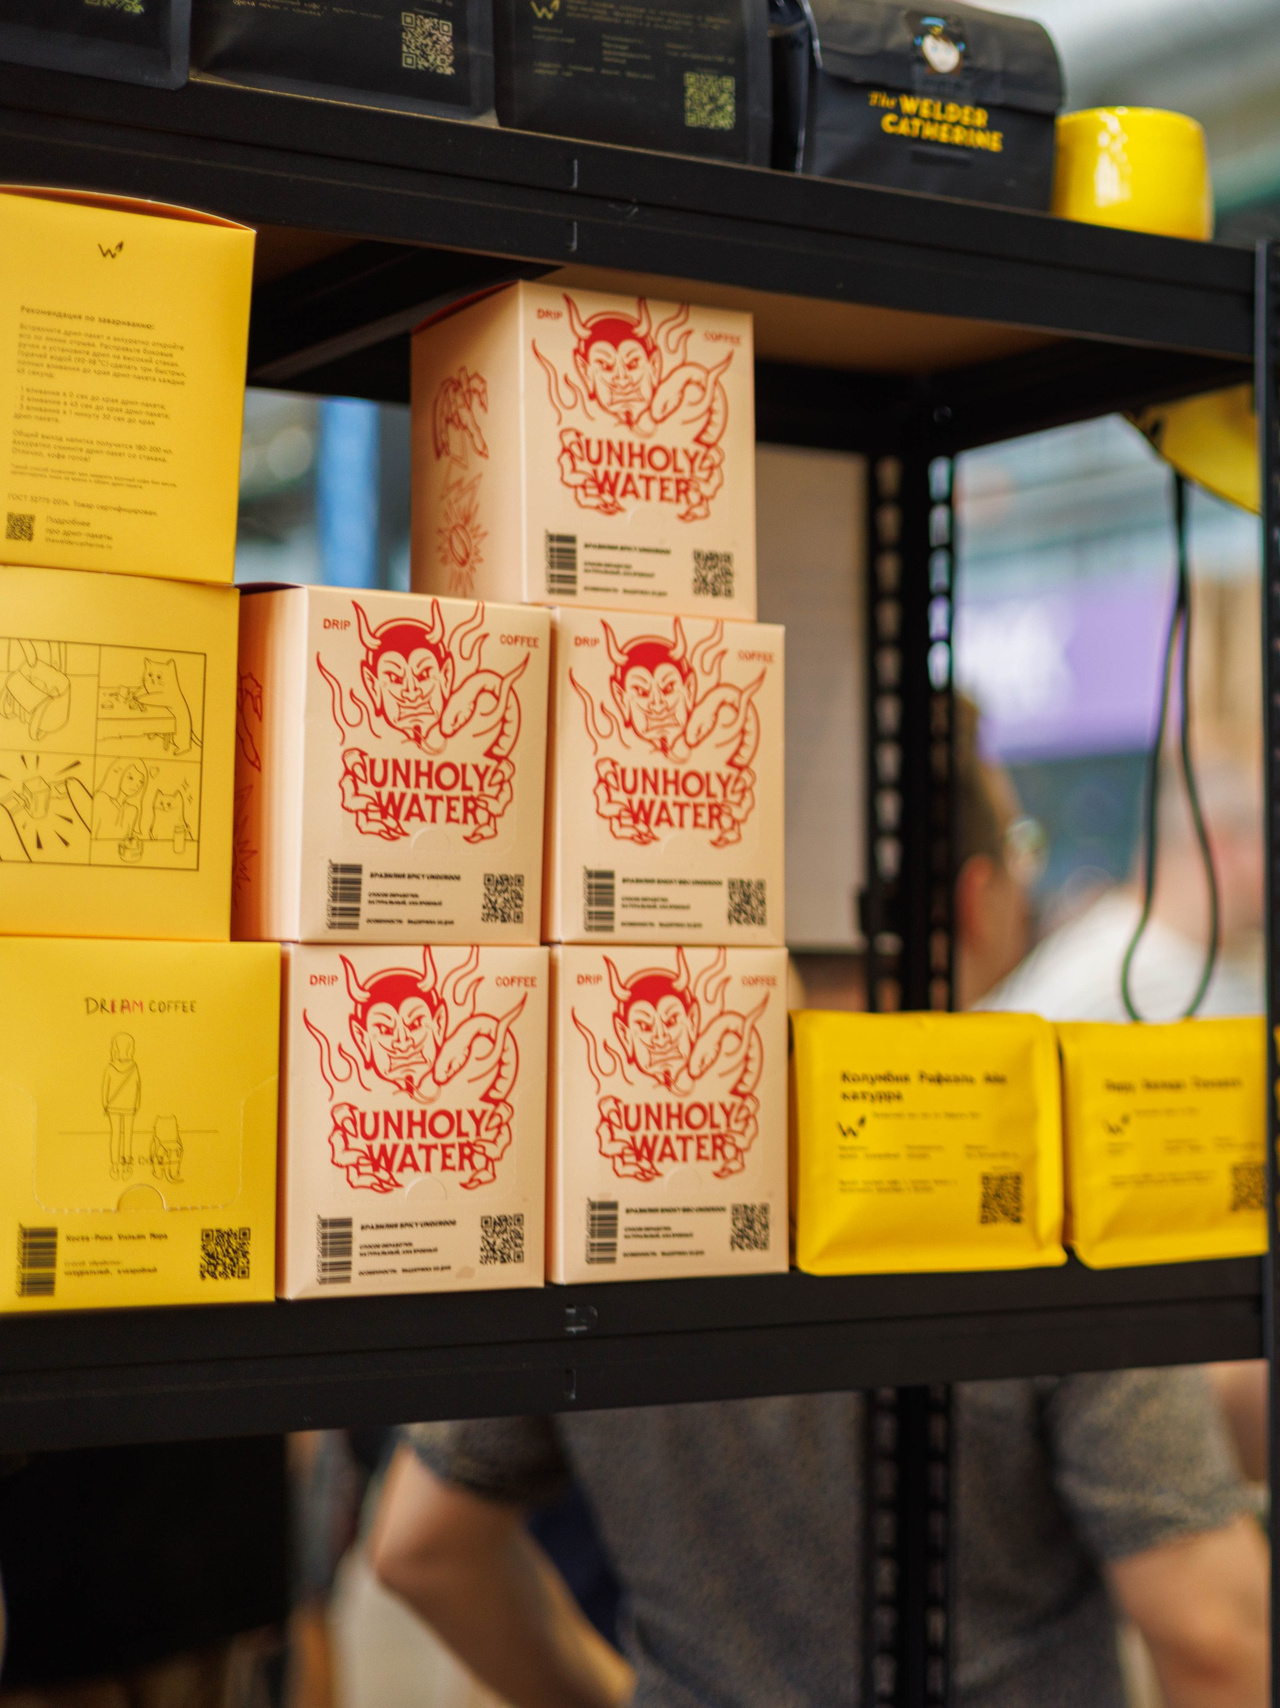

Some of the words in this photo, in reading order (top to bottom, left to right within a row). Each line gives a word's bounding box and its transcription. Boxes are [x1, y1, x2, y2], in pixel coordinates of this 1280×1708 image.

[868, 91, 897, 109] The
[900, 94, 988, 129] WELDER
[882, 112, 1004, 152] CATHERINE
[537, 308, 562, 320] DRIP
[704, 332, 741, 346] COFFEE
[585, 438, 699, 474] UNHOLY
[594, 469, 690, 504] WATER
[323, 618, 351, 630] DRIP
[500, 634, 539, 648] COFFEE
[574, 636, 600, 647] DRIP
[738, 650, 774, 664] COFFEE
[369, 757, 491, 792] UNHOLY
[620, 767, 733, 799] UNHOLY
[376, 790, 478, 824] WATER
[628, 798, 722, 830] WATER
[310, 974, 338, 986] DRIP
[496, 976, 537, 988] COFFEE
[577, 974, 602, 985] DRIP
[741, 975, 778, 986] COFFEE
[149, 1000, 197, 1013] COFFEE
[358, 1109, 488, 1140] UNHOLY
[624, 1102, 736, 1132] UNHOLY
[366, 1140, 476, 1173] WATER
[630, 1134, 726, 1163] WATER
